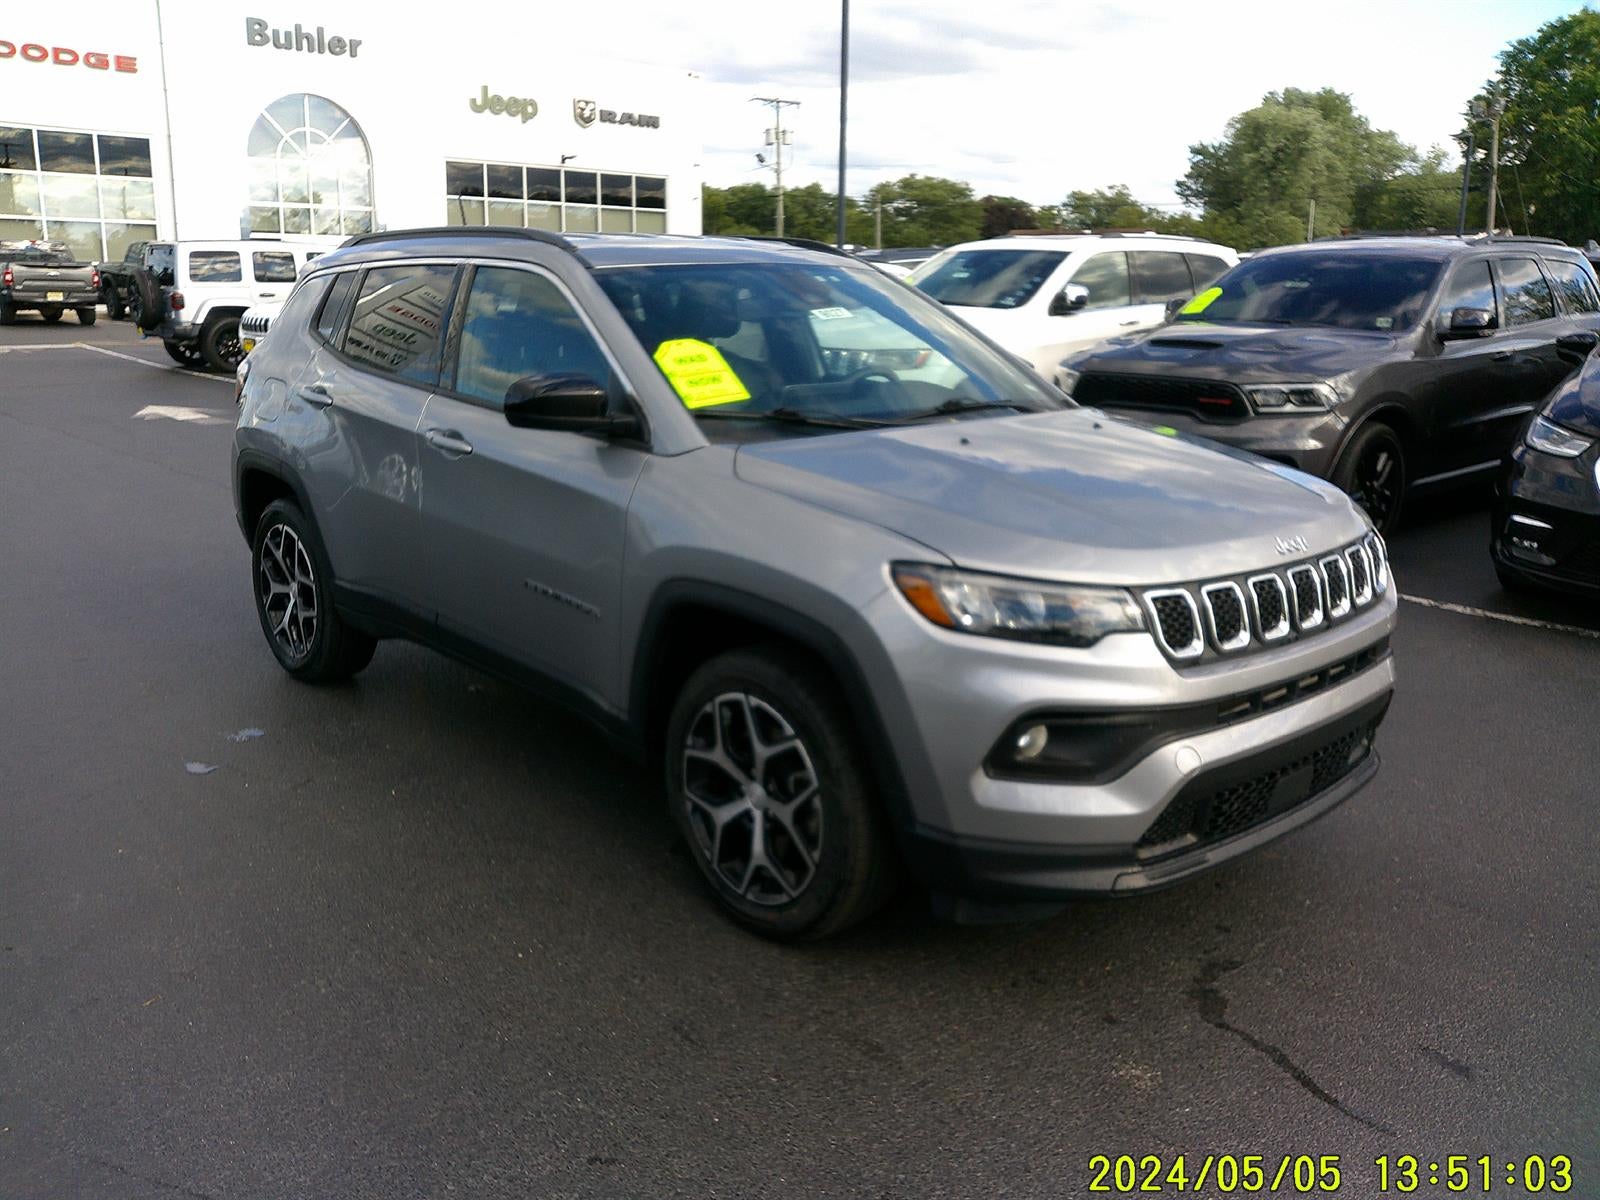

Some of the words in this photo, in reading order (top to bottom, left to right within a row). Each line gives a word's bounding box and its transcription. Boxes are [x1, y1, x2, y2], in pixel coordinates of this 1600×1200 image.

[246, 17, 362, 58] Buhler
[0, 40, 138, 73] DODGE
[469, 85, 538, 124] Jeep
[599, 109, 660, 129] RAM
